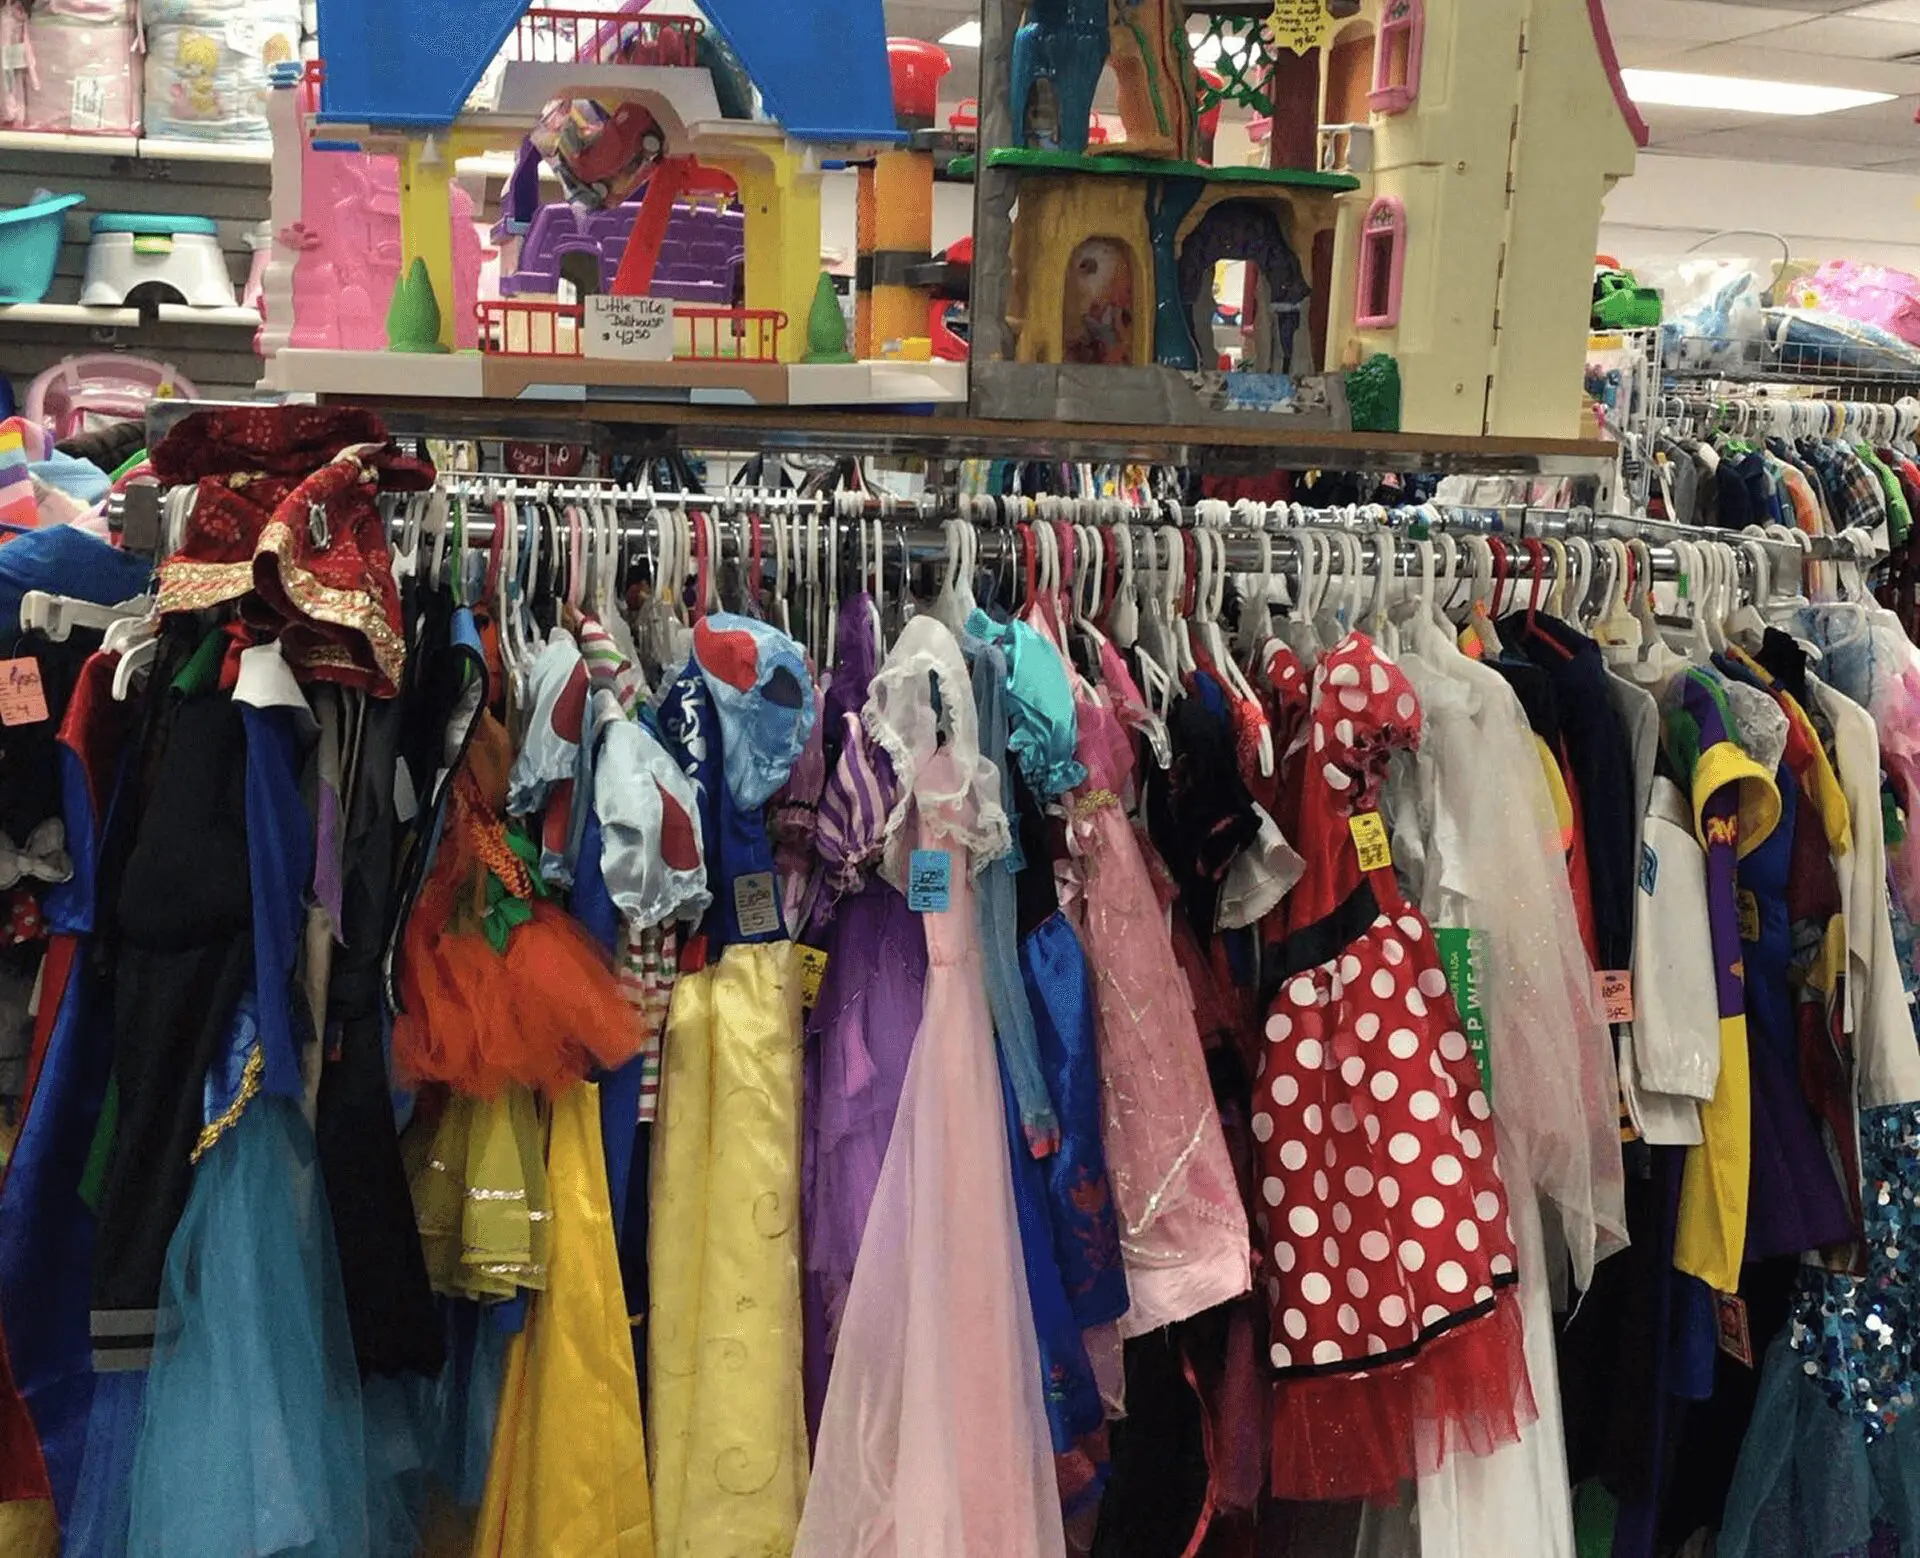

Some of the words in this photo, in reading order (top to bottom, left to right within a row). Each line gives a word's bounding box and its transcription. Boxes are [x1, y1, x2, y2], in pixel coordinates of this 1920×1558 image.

[595, 297, 631, 312] Little
[752, 912, 764, 926] 5
[1449, 954, 1460, 971] USA
